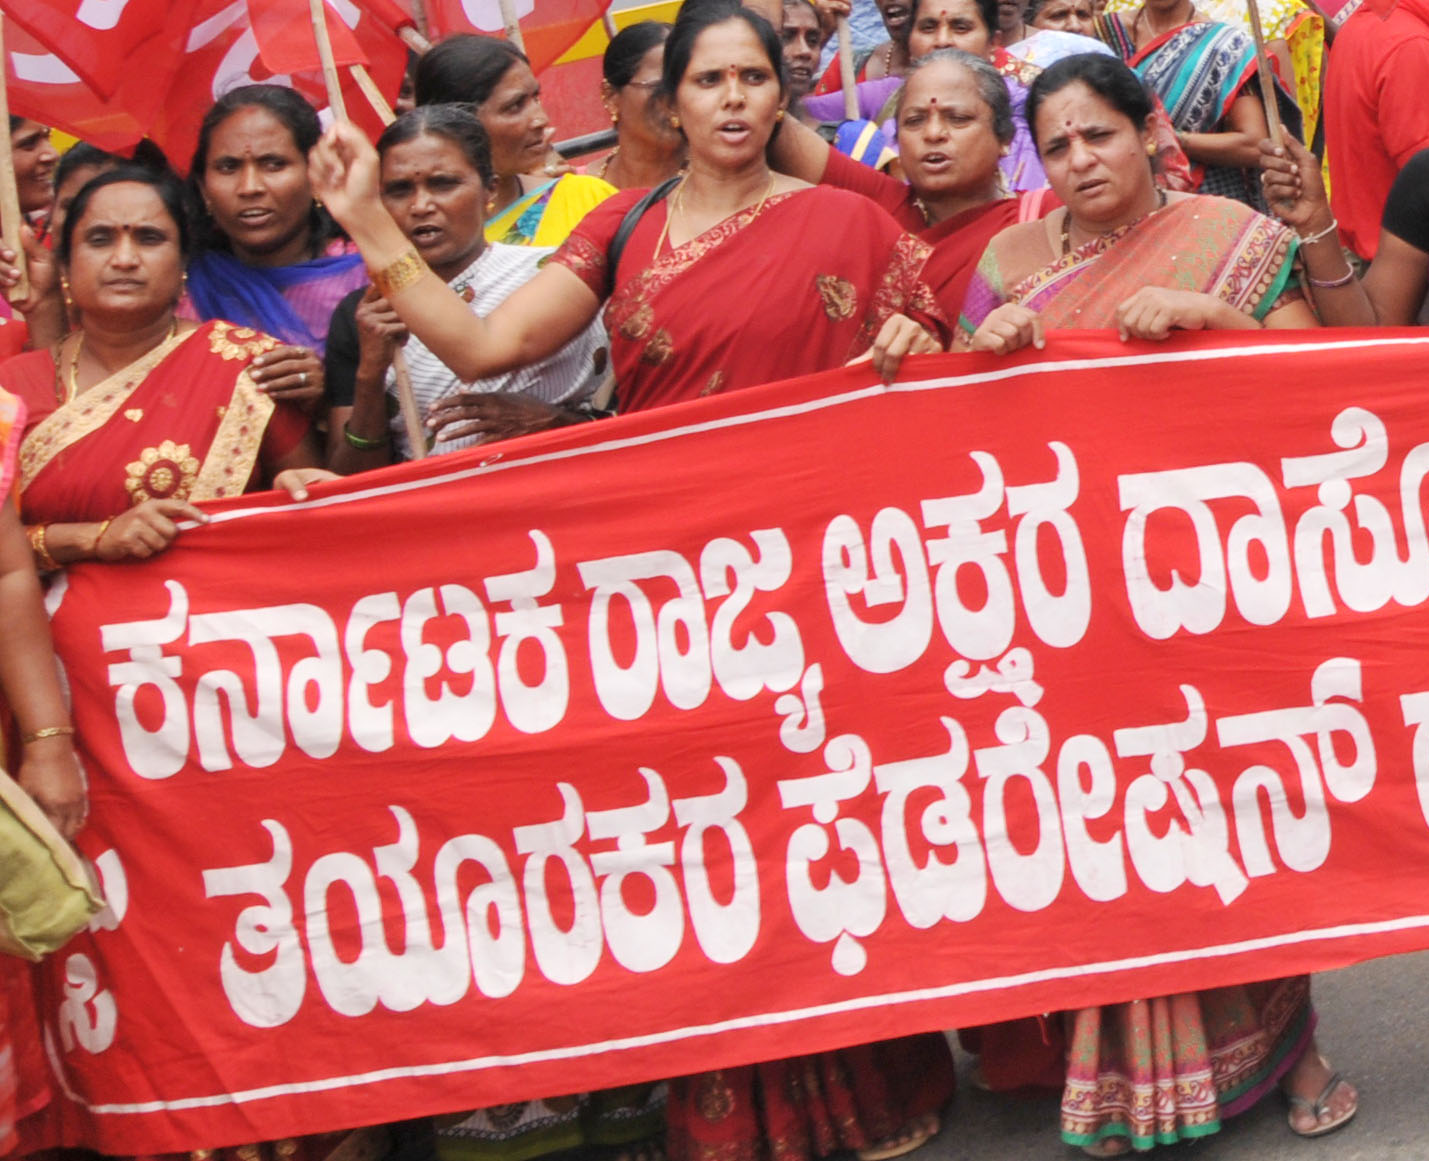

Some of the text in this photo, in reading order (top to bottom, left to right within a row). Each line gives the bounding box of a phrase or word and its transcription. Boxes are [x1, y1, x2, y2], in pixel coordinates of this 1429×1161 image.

[100, 527, 571, 782] ಕರ್ನಾಟಕ
[576, 526, 828, 755] ರಾಜ್ಯ
[822, 440, 1096, 708] ಅಕ್ಷರ
[200, 755, 762, 1029] ತಯಾರಕರ
